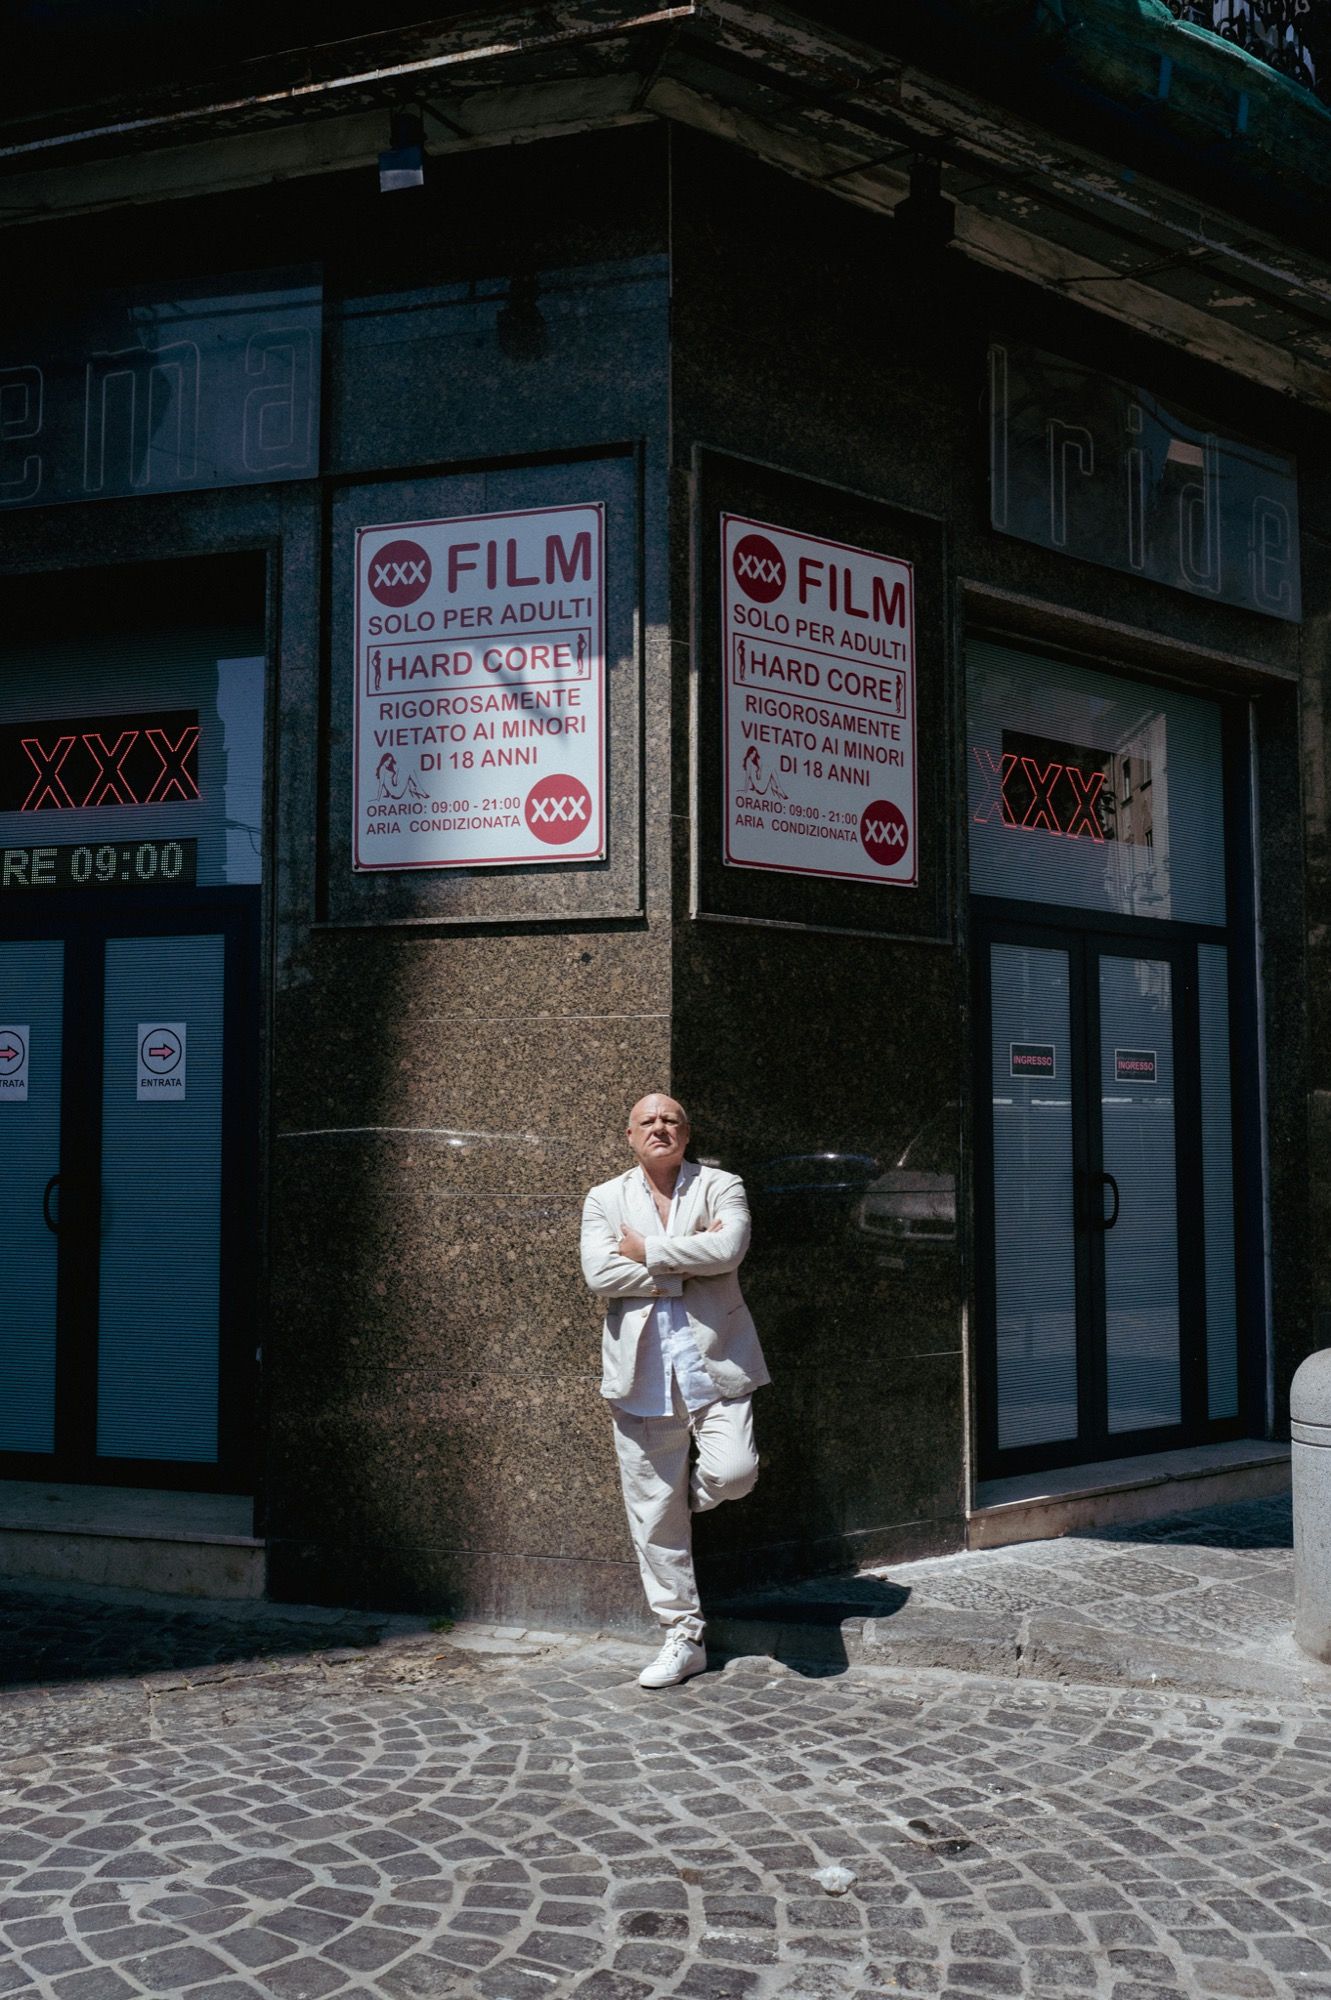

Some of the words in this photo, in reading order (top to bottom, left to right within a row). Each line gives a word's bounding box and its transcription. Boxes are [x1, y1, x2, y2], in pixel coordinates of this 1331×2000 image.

[373, 558, 426, 588] XXX
[447, 531, 592, 594] FILM
[738, 551, 782, 586] XXX
[798, 557, 905, 628] FILM
[368, 611, 435, 636] SOLO
[444, 605, 493, 629] PER
[500, 597, 592, 625] ADULTI
[733, 604, 790, 634] SOLO
[796, 619, 835, 645] PER
[840, 629, 906, 662] ADULTI
[387, 651, 473, 682] HARD
[482, 643, 571, 673] CORE
[750, 650, 820, 687] HARD
[827, 667, 893, 703] CORE
[379, 688, 581, 721] RIGOROSAMENTE
[745, 694, 901, 741] RIGOROSAMENTE
[374, 724, 466, 748] VIETATO
[473, 721, 495, 741] AI
[502, 715, 586, 739] MINORI
[741, 720, 817, 752] VIETATO
[821, 735, 839, 754] AI
[843, 739, 904, 767] MINORI
[21, 726, 203, 812] XXX
[420, 752, 442, 772] DI
[449, 750, 474, 769] 18
[481, 746, 538, 768] ANNI
[780, 754, 798, 775] DI
[803, 759, 823, 779] 18
[828, 764, 870, 787] ANNI
[367, 803, 428, 818] ORARIO:
[431, 799, 470, 814] 09:00
[482, 796, 521, 811] 21:00
[530, 795, 586, 823] XXX
[735, 795, 786, 815] ORARIO:
[788, 803, 820, 820] 09:00
[828, 809, 858, 826] 21:00
[972, 746, 1106, 844] XXX
[366, 822, 401, 835] ARIA
[409, 815, 521, 834] CONDIZIONATA
[735, 813, 764, 830] ARIA
[771, 818, 858, 843] CONDIZIONATA
[864, 818, 905, 848] XXX
[3, 848, 58, 886] RE
[71, 842, 183, 882] 09:00
[1013, 1055, 1052, 1066] INGRESSO
[1118, 1060, 1154, 1071] INGRESSO
[141, 1078, 182, 1087] ENTRATA
